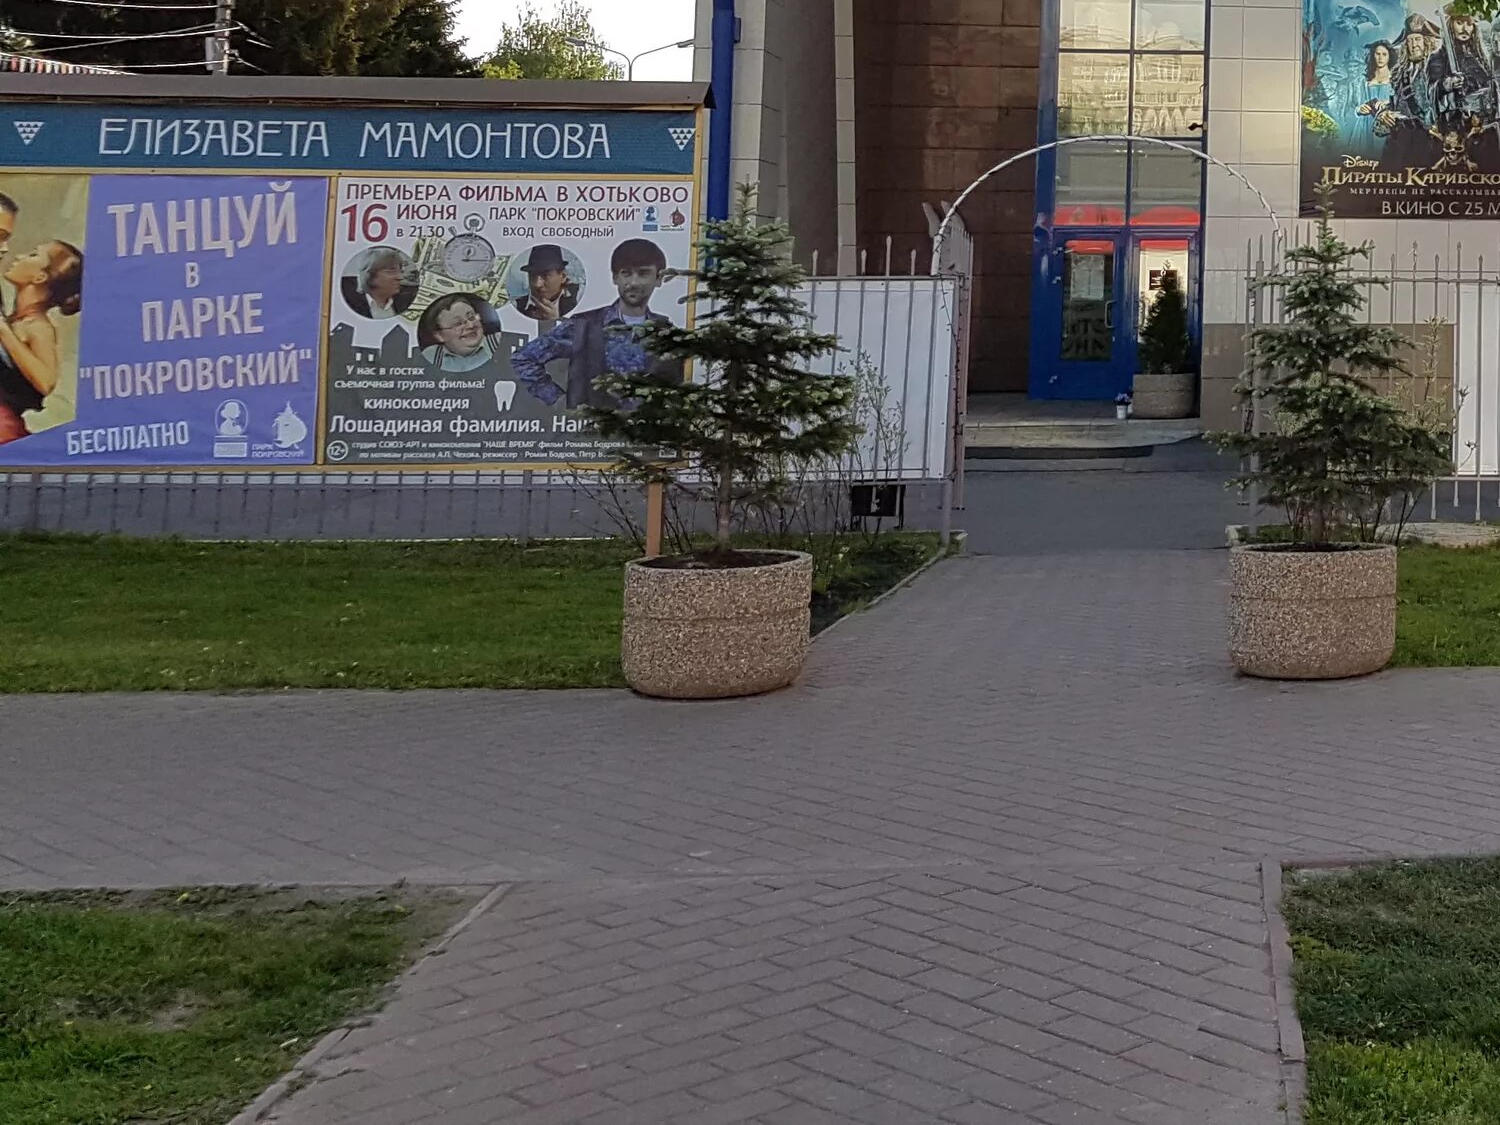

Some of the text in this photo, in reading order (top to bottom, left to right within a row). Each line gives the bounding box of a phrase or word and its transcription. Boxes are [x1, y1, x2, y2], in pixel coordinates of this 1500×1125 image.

[99, 118, 611, 159] ЕЛИЗАВЕТА МАМОНТОВА
[1341, 154, 1379, 170] Disney
[346, 184, 689, 203] ПРЕМЬЕРА ФИЛЬМА В ХОТЬКОВО
[396, 205, 641, 221] ИЮНЯ ПАРК "ПОКРОВСКИЙ"
[1382, 201, 1392, 215] В
[1395, 201, 1444, 215] КИНО
[1449, 201, 1460, 215] С
[1464, 201, 1484, 215] 25
[107, 181, 297, 258] ТАНЦУЙ
[341, 203, 388, 242] 16
[409, 226, 445, 239] 21.30
[503, 227, 534, 238] ВХОД
[542, 225, 614, 238] СВОБОДНЫЙ
[185, 262, 199, 288] В
[142, 293, 264, 342] ПАРКЕ
[80, 343, 312, 400] "ПОКРОВСКИЙ"
[346, 365, 424, 376] У нас в гостях
[397, 380, 435, 390] группа
[438, 378, 485, 391] фильма!
[364, 398, 470, 412] кинокомедия
[329, 415, 442, 437] Лошадиная
[450, 415, 545, 437] фамилия.
[66, 421, 189, 456] БЕСПЛАТНО
[329, 445, 346, 456] 12+
